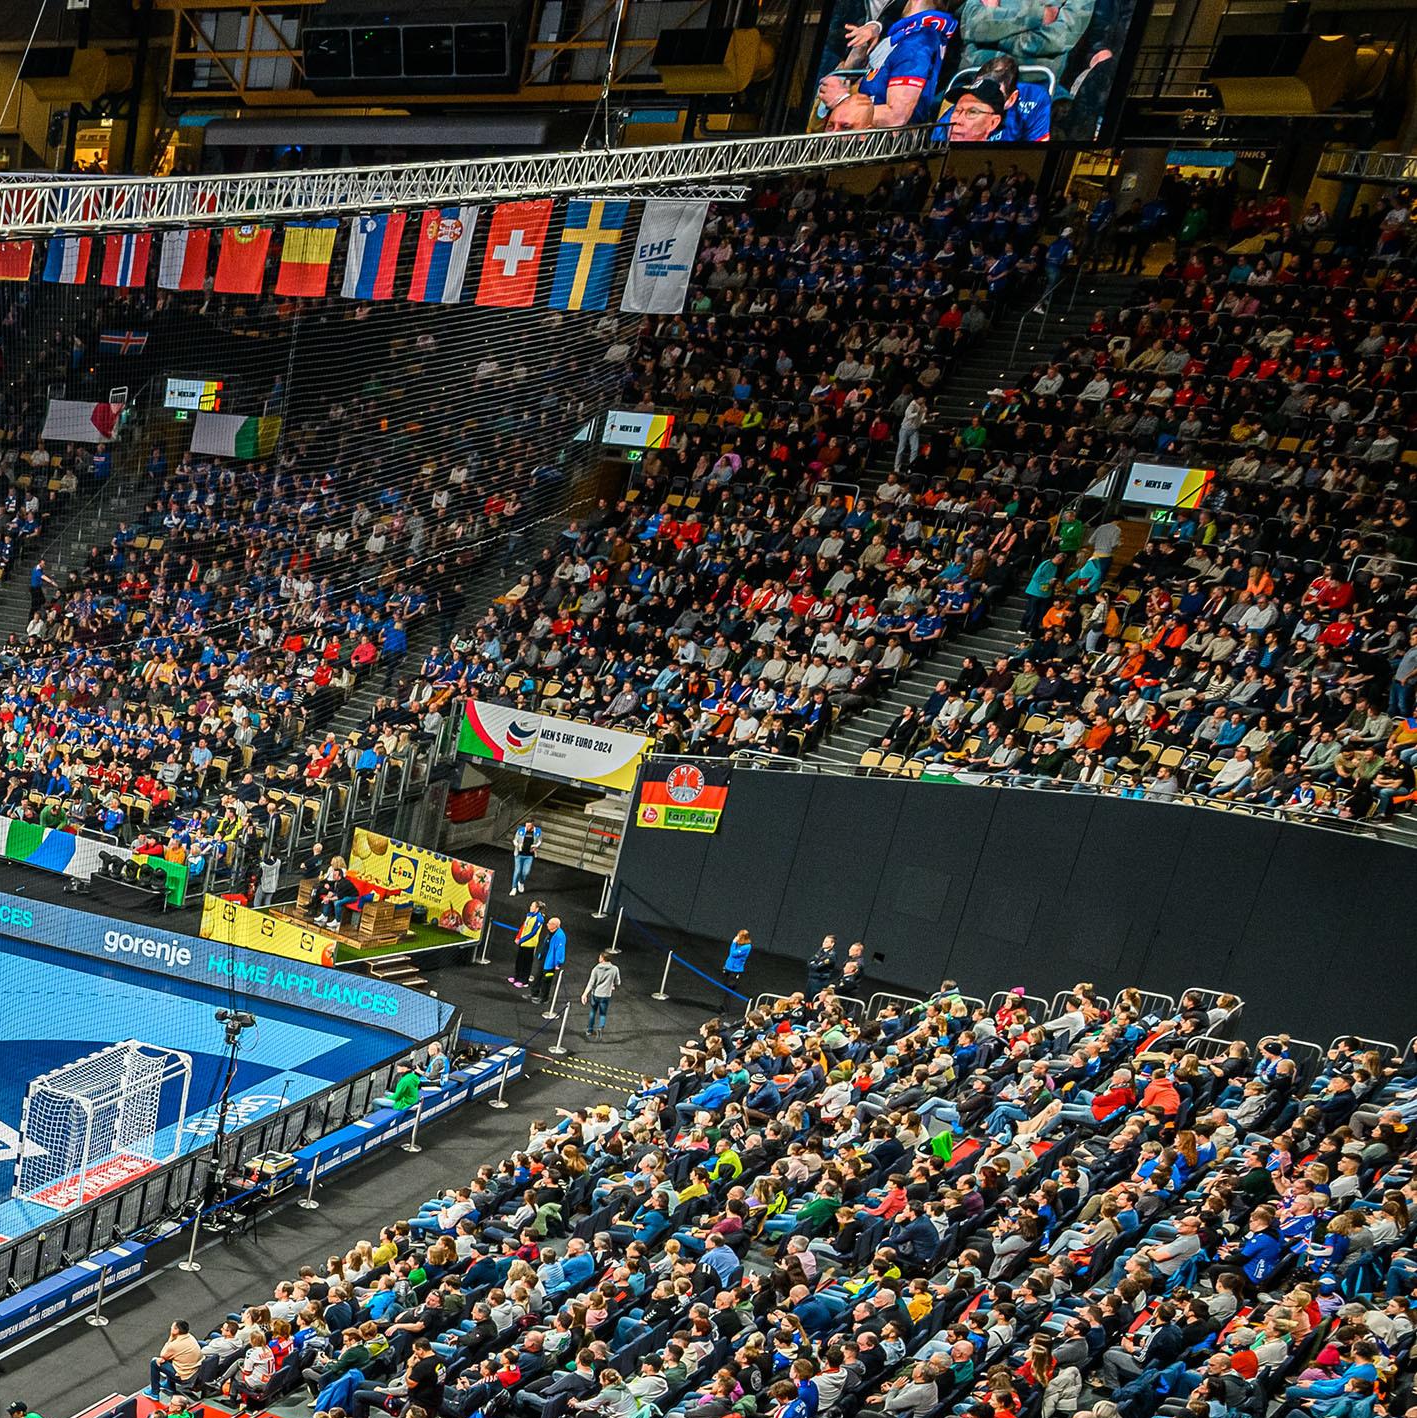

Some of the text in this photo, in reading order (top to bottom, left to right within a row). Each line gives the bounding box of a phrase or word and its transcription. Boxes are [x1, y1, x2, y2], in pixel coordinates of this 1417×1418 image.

[639, 239, 676, 259] EHF
[562, 733, 574, 745] EHF
[575, 736, 593, 750] EURO
[594, 740, 613, 754] 2024
[422, 870, 446, 886] Fresh
[423, 862, 447, 876] Official
[420, 881, 444, 897] Food
[104, 930, 399, 1016] gorenje HOME APPLIANCES
